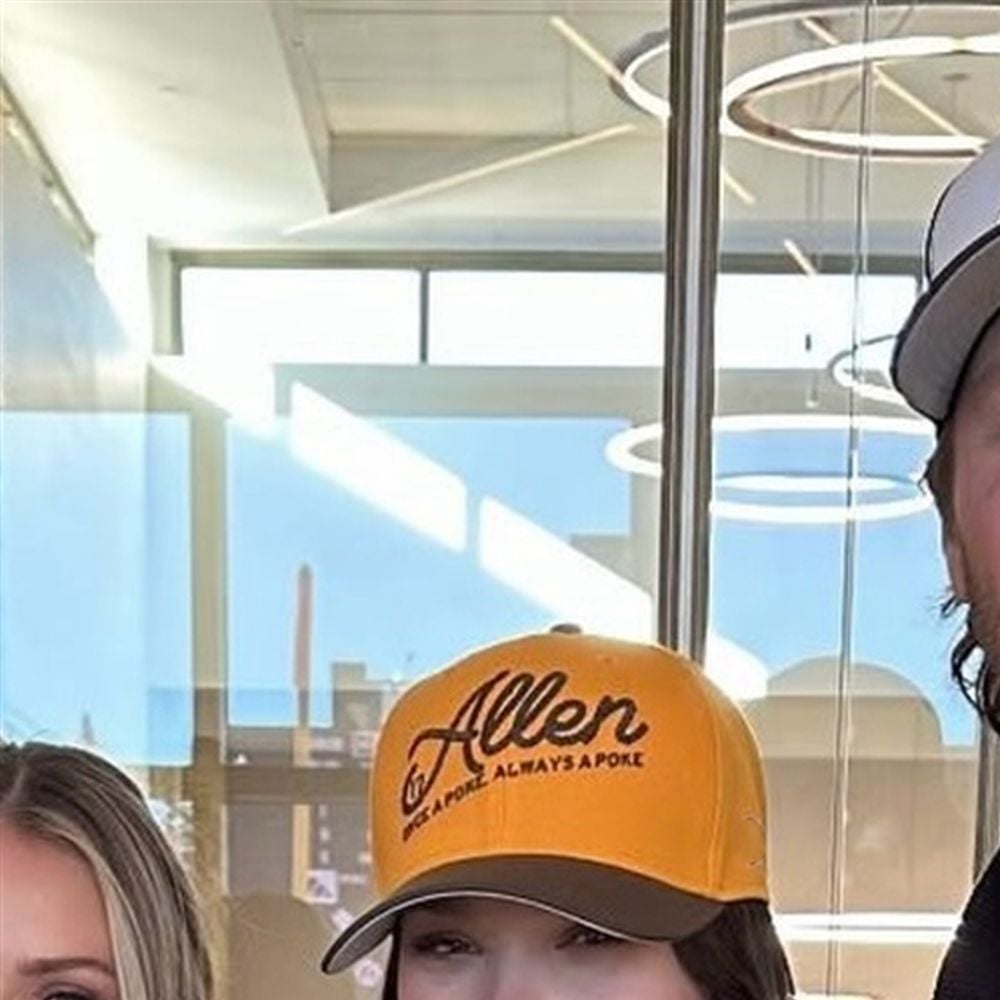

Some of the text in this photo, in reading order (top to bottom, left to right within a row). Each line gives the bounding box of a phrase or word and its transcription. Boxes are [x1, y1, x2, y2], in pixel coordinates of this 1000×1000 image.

[402, 670, 649, 815] Allen
[431, 799, 443, 815] A
[493, 754, 575, 781] ALWAYS
[578, 753, 592, 770] A
[594, 751, 644, 769] POKE
